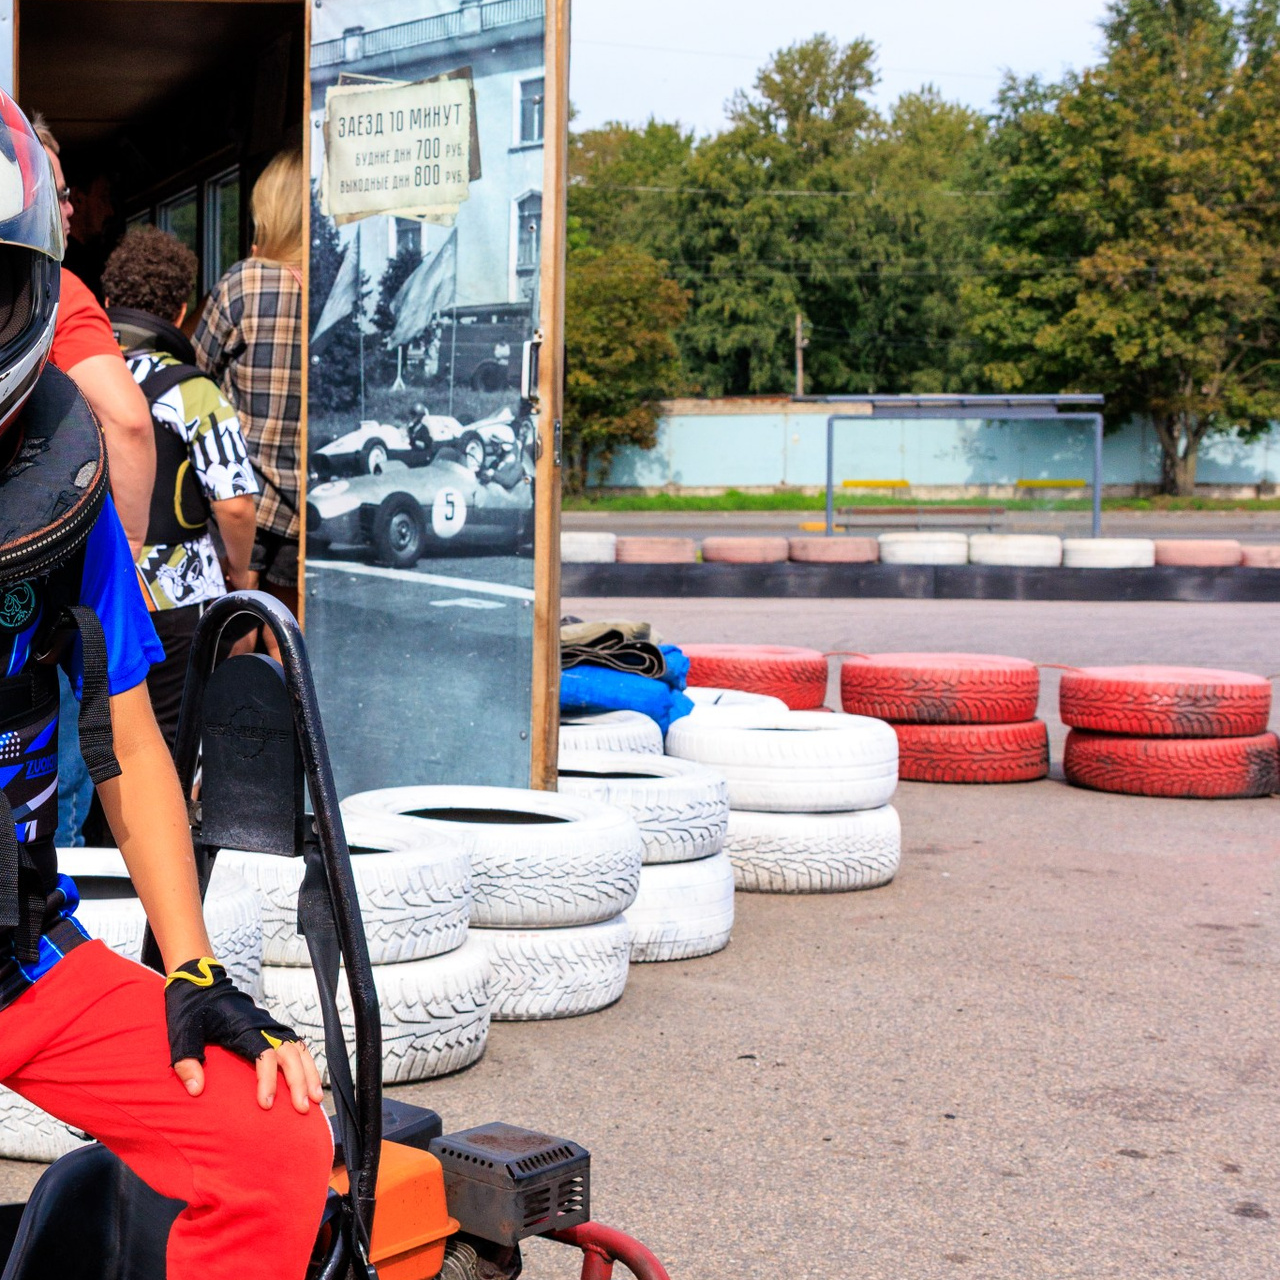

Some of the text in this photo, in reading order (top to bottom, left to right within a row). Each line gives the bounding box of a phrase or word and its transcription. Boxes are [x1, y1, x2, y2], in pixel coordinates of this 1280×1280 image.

[338, 103, 462, 138] ЗАЕЗД 10 МИНУТ
[355, 149, 391, 167] БУДНИЕ
[393, 148, 412, 163] ДНИ
[417, 137, 440, 160] 700
[340, 175, 389, 194] ВЫХОДНЫЕ
[392, 175, 410, 189] ДНИ
[414, 164, 440, 187] 800
[445, 493, 455, 521] 5
